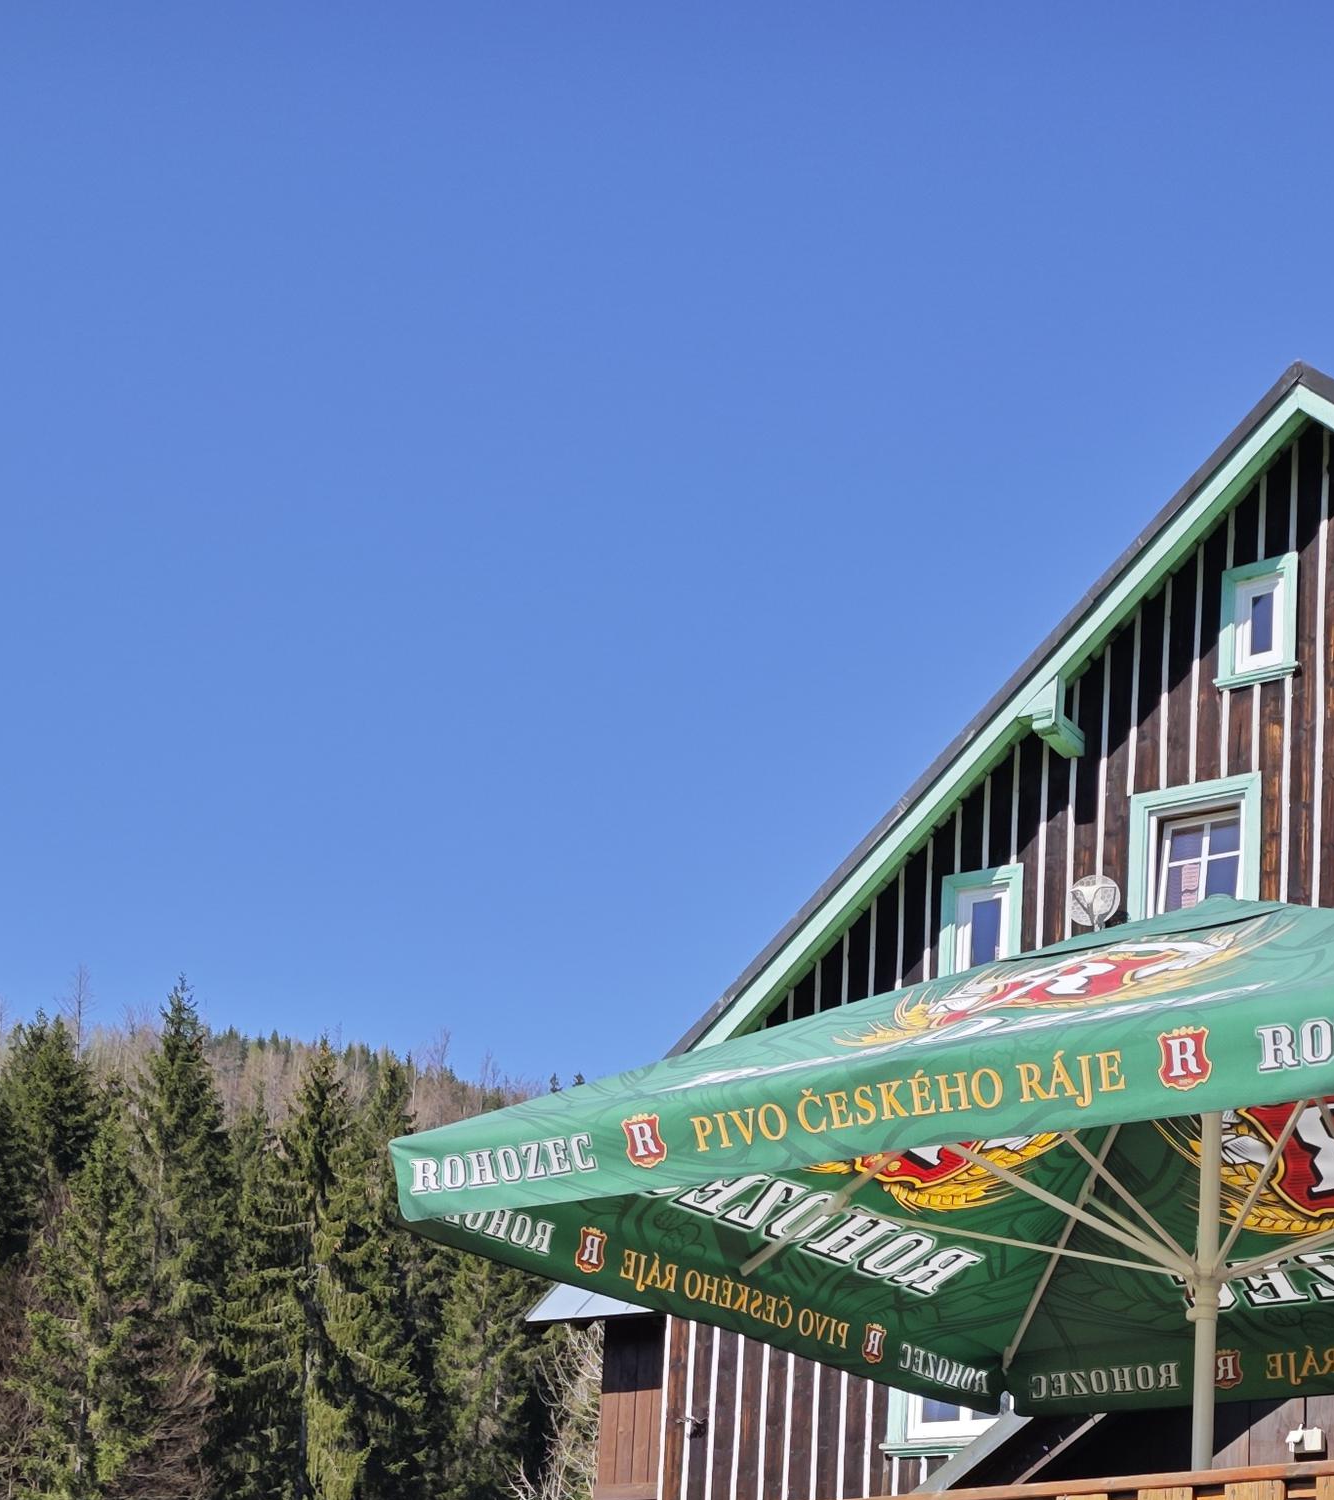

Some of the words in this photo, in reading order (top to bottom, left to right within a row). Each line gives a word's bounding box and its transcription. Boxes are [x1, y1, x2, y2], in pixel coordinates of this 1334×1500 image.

[410, 1133, 597, 1195] ROHOZEC
[628, 1122, 661, 1157] R
[689, 1101, 788, 1153] PIVO
[796, 1068, 1005, 1136] ČESKÉHO
[1017, 1049, 1127, 1108] RÁJE
[1166, 1036, 1202, 1077] R
